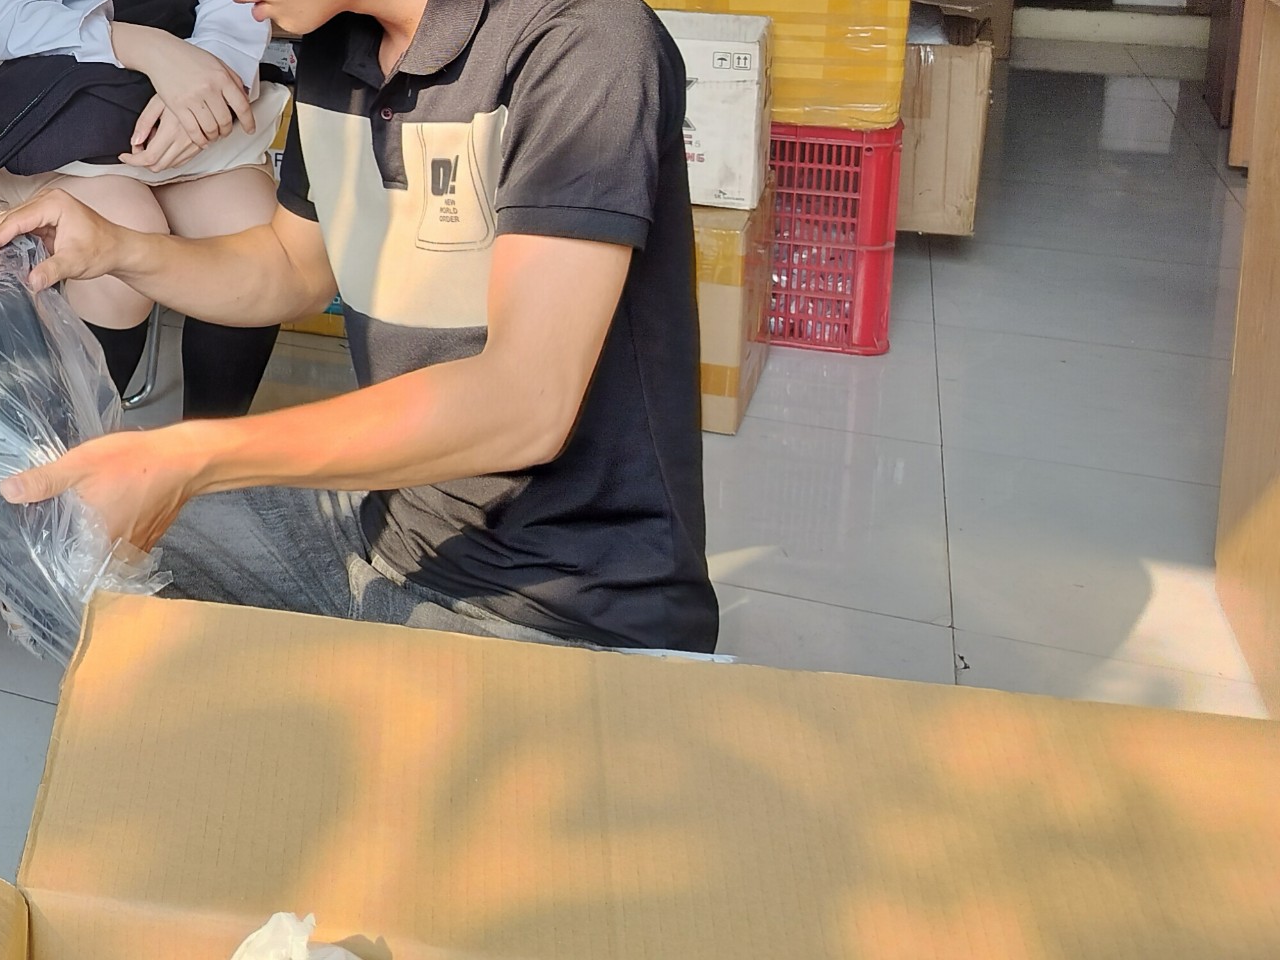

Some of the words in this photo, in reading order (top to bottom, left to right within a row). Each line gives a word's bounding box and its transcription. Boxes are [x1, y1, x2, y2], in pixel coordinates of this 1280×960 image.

[444, 198, 456, 206] NEW
[439, 207, 458, 215] WORLD
[439, 215, 460, 223] ORDER
